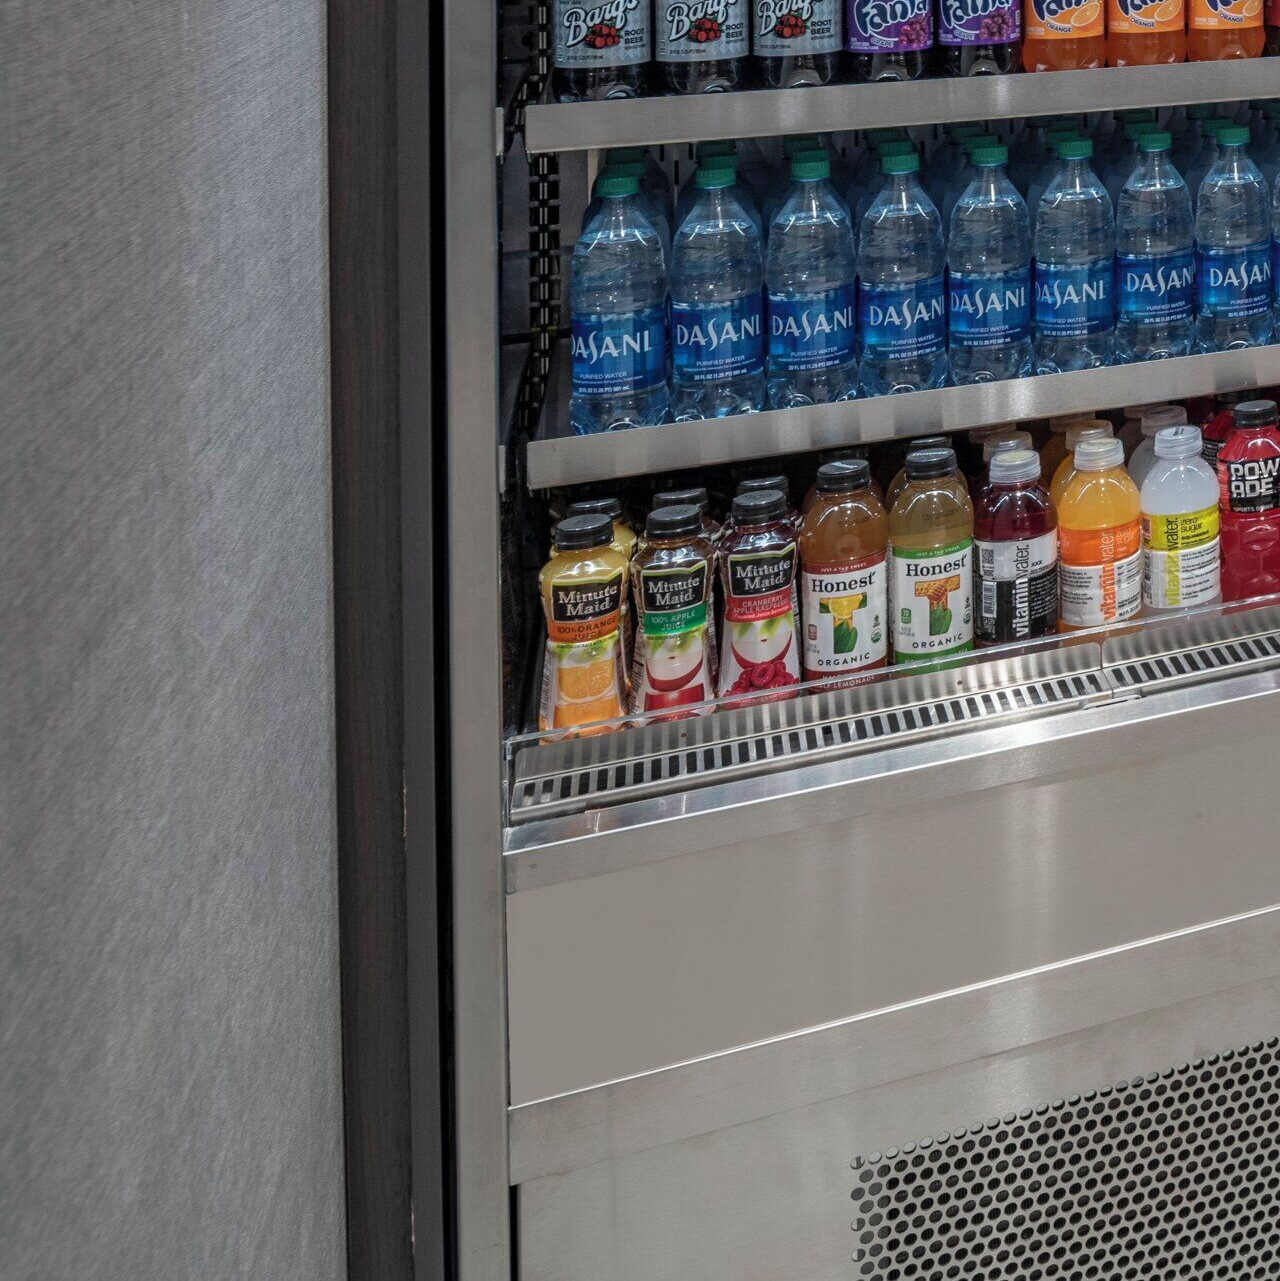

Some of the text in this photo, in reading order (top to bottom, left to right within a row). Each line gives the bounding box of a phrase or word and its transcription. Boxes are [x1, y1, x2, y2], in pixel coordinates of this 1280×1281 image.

[625, 28, 644, 36] ROOT
[726, 23, 744, 31] ROOT
[811, 27, 831, 35] BEER
[1045, 23, 1072, 33] ORANGE
[625, 37, 643, 45] BEER
[871, 37, 894, 48] GRAPE
[1210, 262, 1270, 291] DASAN
[951, 287, 1026, 319] DASANI
[870, 295, 944, 330] DASANI
[772, 306, 853, 342] DASANI
[677, 314, 760, 351] DASANI
[1181, 517, 1199, 526] zero
[1181, 522, 1203, 533] sugar
[736, 560, 790, 578] Minute
[906, 554, 967, 577] Honest
[648, 577, 700, 593] Minute
[744, 576, 786, 591] Maid
[811, 571, 876, 593] Honest
[558, 585, 617, 604] Minute
[656, 589, 695, 606] Maid
[742, 594, 783, 607] CRANBERRY
[566, 598, 613, 616] Maid
[671, 611, 696, 622] APPLE
[557, 617, 617, 634] 100% ORANGE
[912, 632, 963, 649] ORGANIC
[818, 652, 870, 666] ORGANIC
[833, 676, 875, 688] LEMONADE
